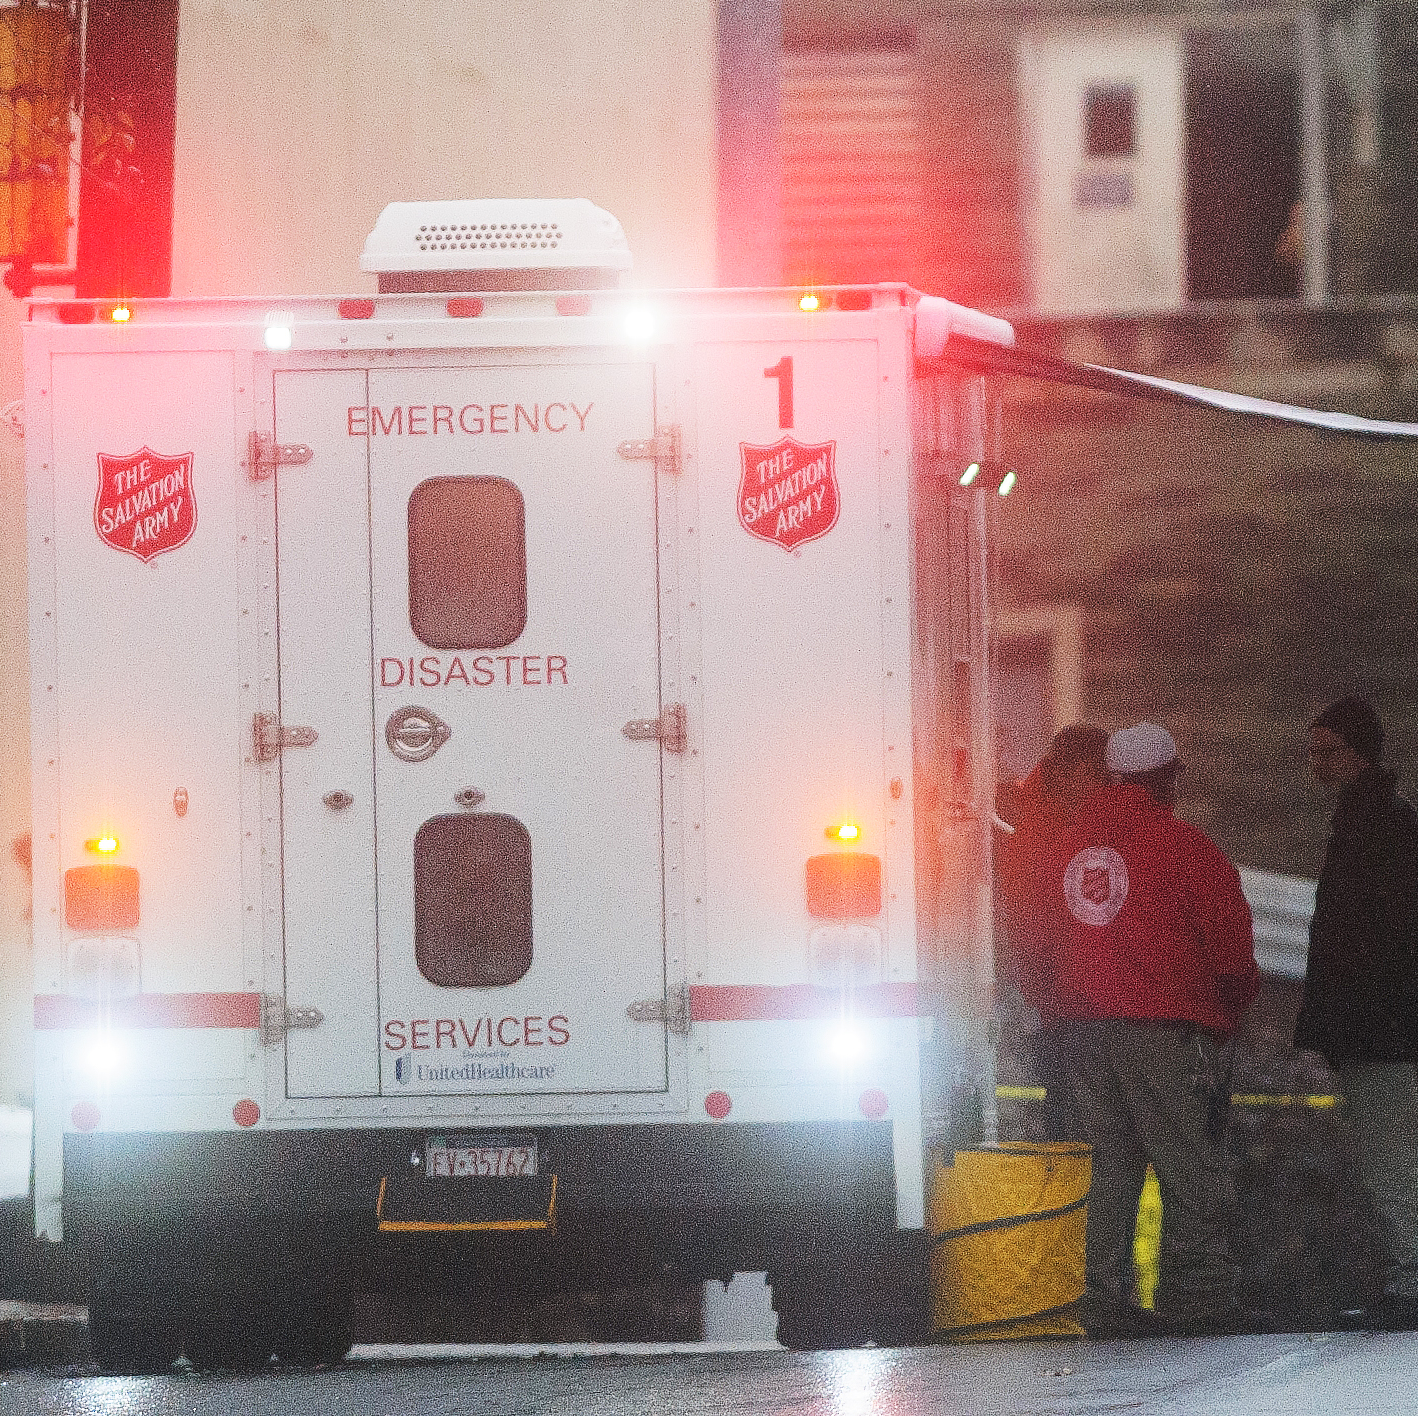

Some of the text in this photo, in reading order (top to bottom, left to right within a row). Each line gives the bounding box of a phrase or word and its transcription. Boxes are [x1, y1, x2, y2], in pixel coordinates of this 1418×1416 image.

[763, 355, 794, 429] 1
[346, 402, 595, 437] EMERGENCY
[114, 458, 152, 495] THE
[756, 448, 794, 484] THE
[101, 463, 185, 534] SALVATION
[744, 451, 828, 524] SALVATION
[132, 495, 183, 548] ARMY
[774, 484, 826, 538] ARMY
[379, 654, 570, 688] DISASTER
[384, 1015, 571, 1051] SERVICES
[416, 1062, 556, 1082] UnitedHealthcare
